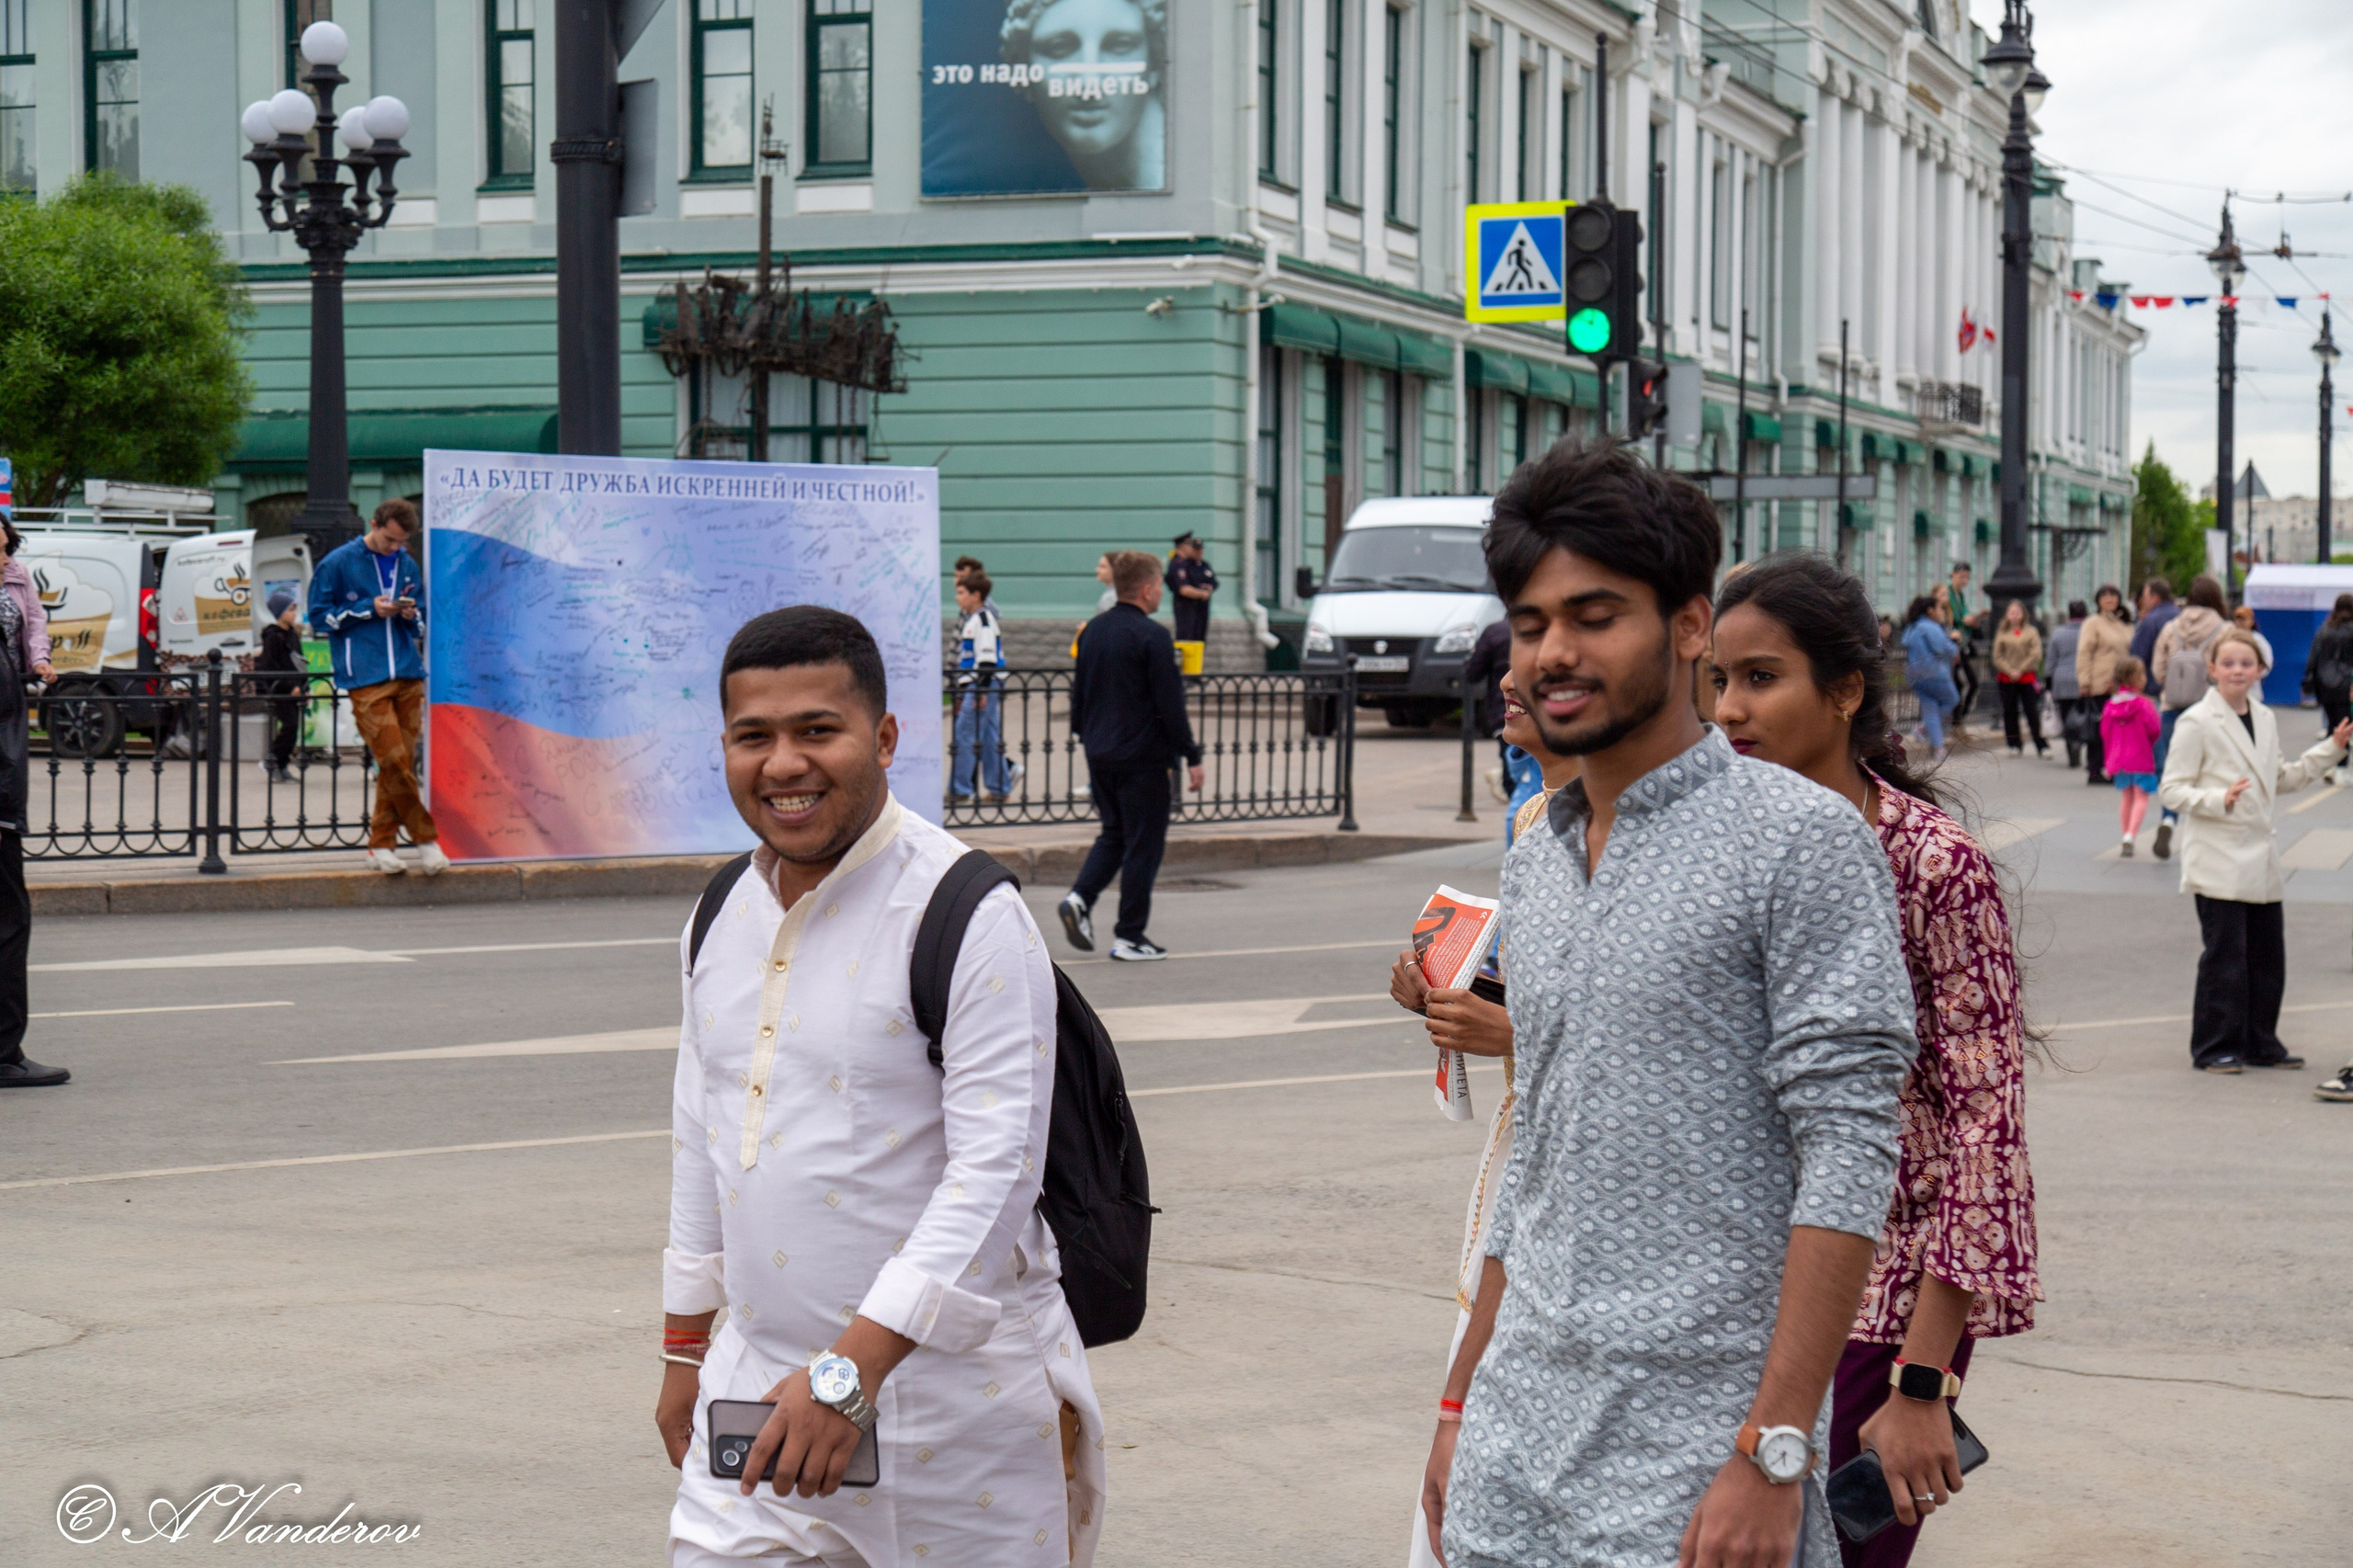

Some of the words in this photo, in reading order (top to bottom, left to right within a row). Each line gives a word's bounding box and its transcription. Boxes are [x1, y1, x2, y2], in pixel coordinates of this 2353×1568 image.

[931, 64, 974, 85] это
[980, 62, 1045, 87] надо
[1048, 74, 1149, 100] видеть
[488, 469, 553, 491] БУДЕТ
[560, 472, 651, 494] ДРУЖБА
[657, 475, 787, 499] ИСКРЕННЕЙ
[792, 480, 806, 499] И
